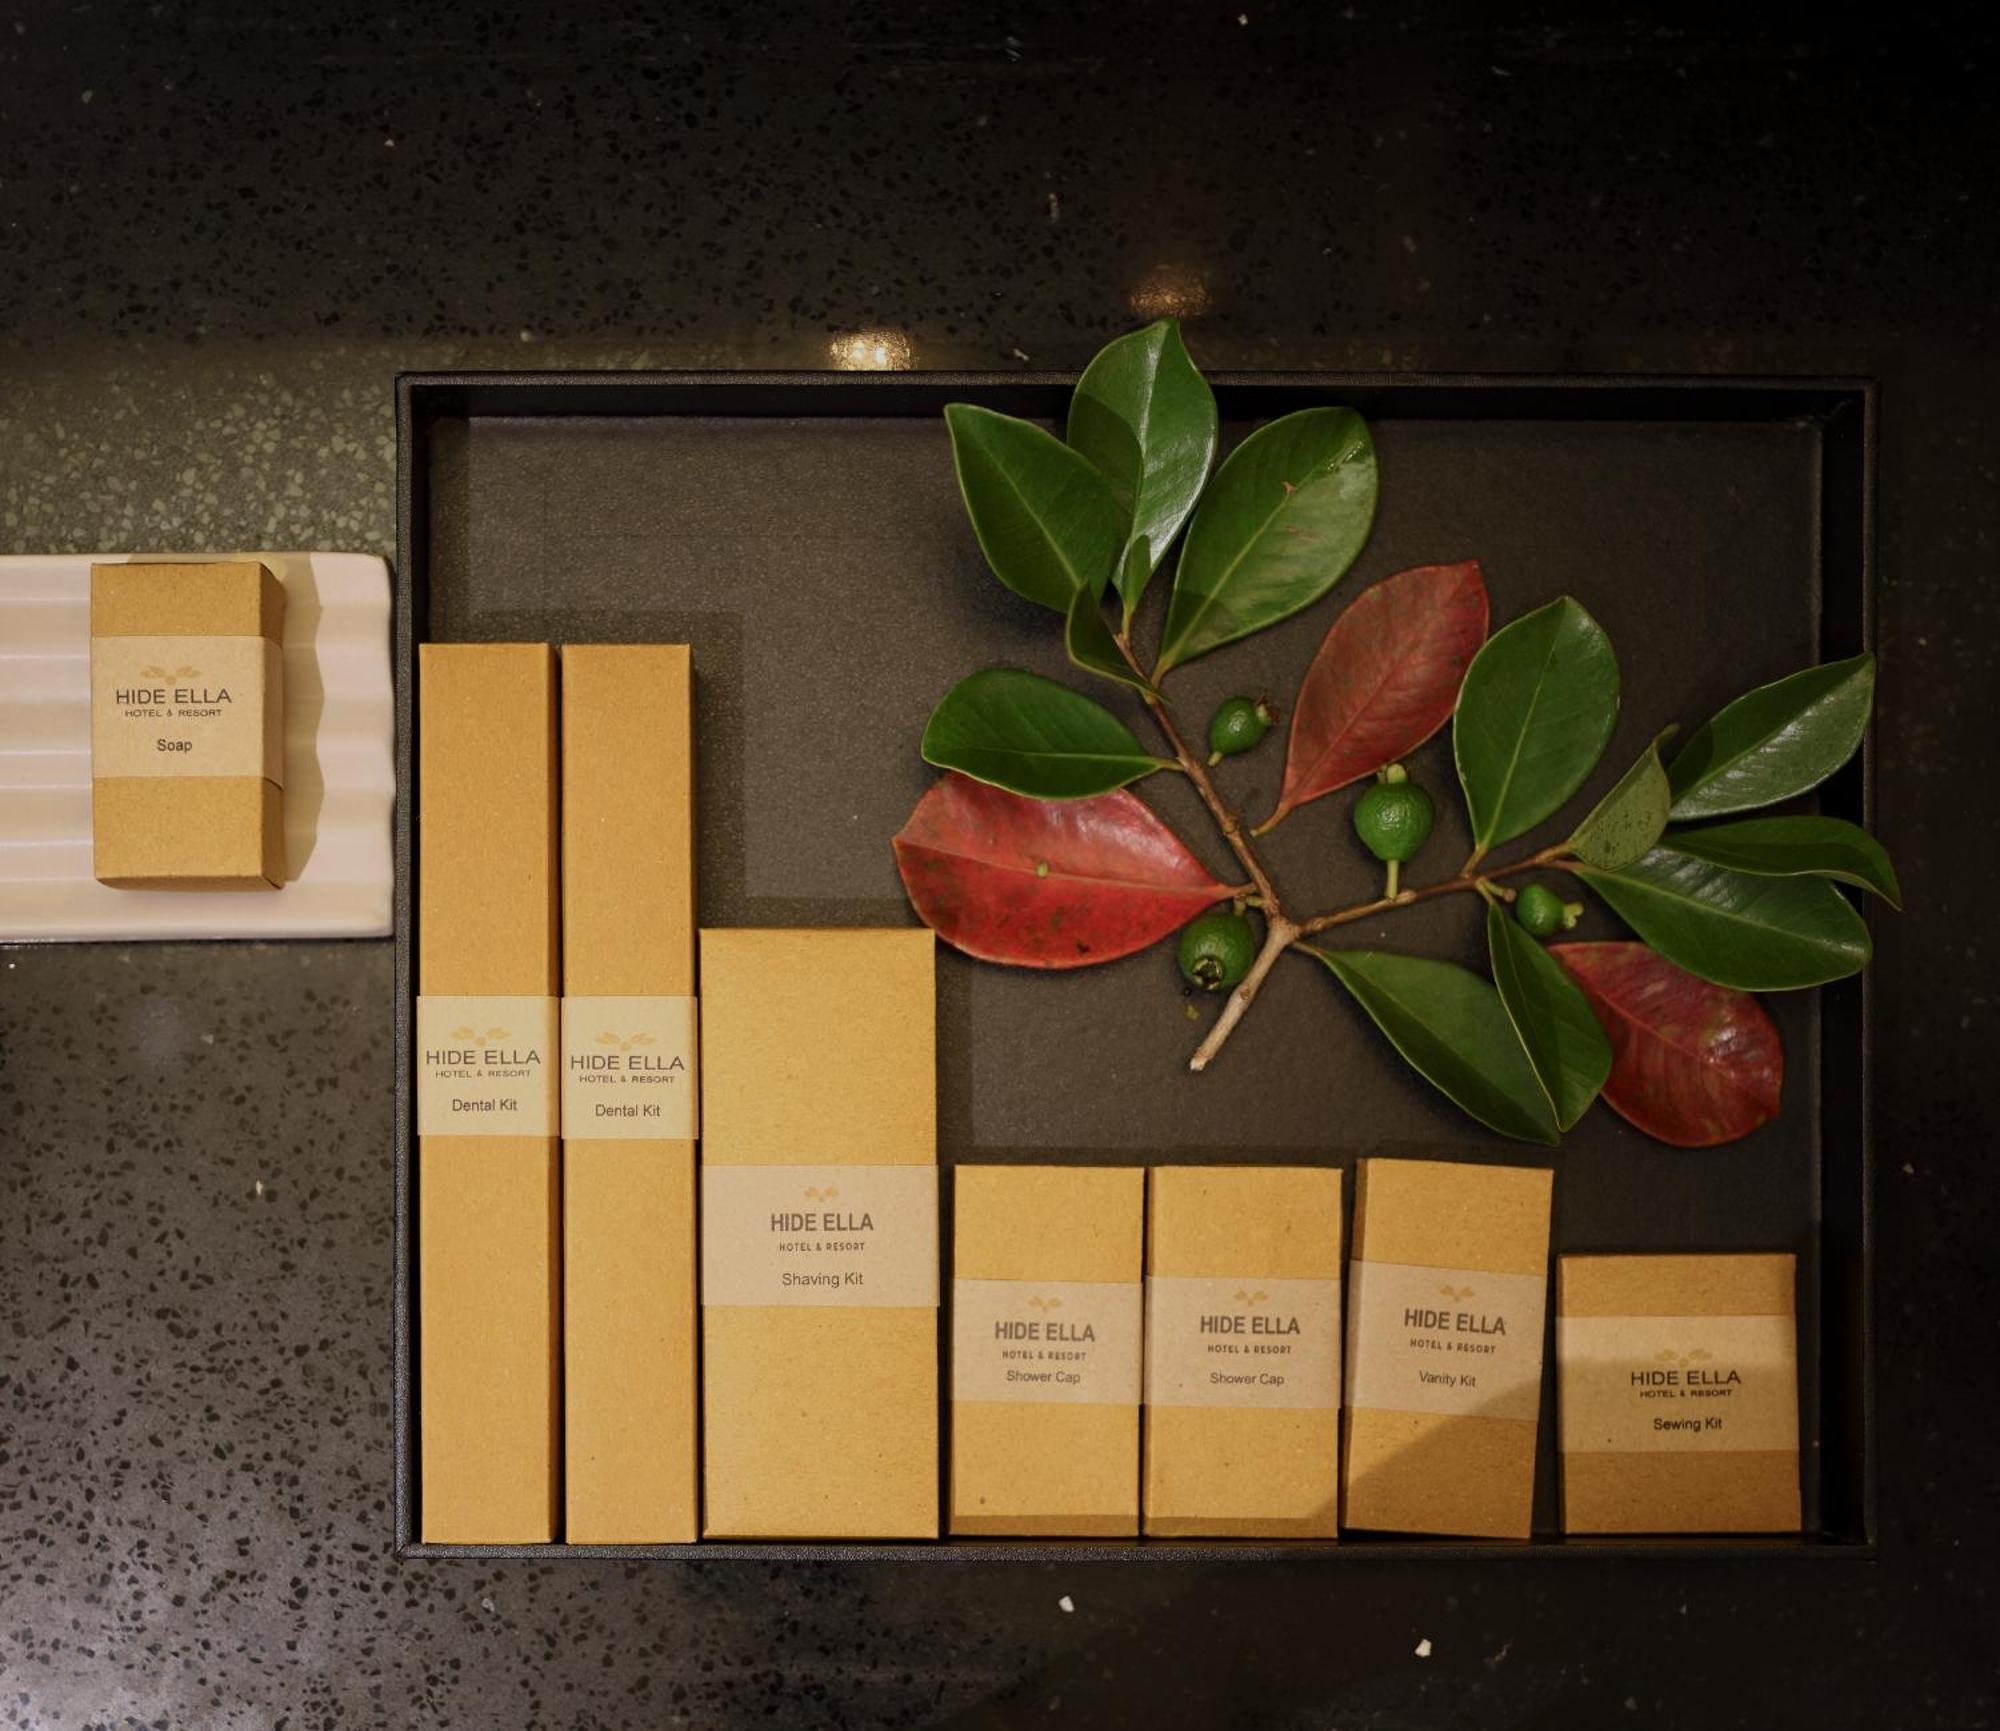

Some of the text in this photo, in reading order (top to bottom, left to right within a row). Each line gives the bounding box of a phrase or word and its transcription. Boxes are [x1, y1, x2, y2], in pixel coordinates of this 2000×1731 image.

[116, 688, 232, 705] HIDE ELLA
[125, 709, 223, 717] HOTEL & RESORT
[157, 738, 193, 754] Soap
[425, 1050, 541, 1065] HIDE ELLA
[570, 1055, 685, 1071] HIDE ELLA
[435, 1069, 531, 1079] HOTEL & RESORT
[579, 1075, 675, 1084] HOTEL & RESORT
[452, 1098, 517, 1112] Dental Kit
[595, 1104, 661, 1117] Dental Kit
[770, 1212, 874, 1232] HIDE ELLA
[779, 1242, 865, 1252] HOTEL & RESORT
[782, 1272, 864, 1288] Shaving Kit
[1200, 1315, 1300, 1335] HIDE ELLA
[1404, 1308, 1506, 1336] HIDE ELLA
[995, 1321, 1095, 1342] HIDE ELLA
[1208, 1344, 1291, 1354] HOTEL & RESORT
[1410, 1339, 1496, 1354] HOTEL & RESORT
[1002, 1350, 1087, 1361] HOTEL & RESORT
[1006, 1370, 1081, 1384] Shower Cap
[1210, 1371, 1284, 1386] Shower Cap
[1419, 1371, 1477, 1388] Vanity Kit
[1631, 1370, 1742, 1387] HIDE ELLA
[1640, 1389, 1732, 1398] HOTEL & RESORT
[1653, 1417, 1722, 1433] Sewing Kit
